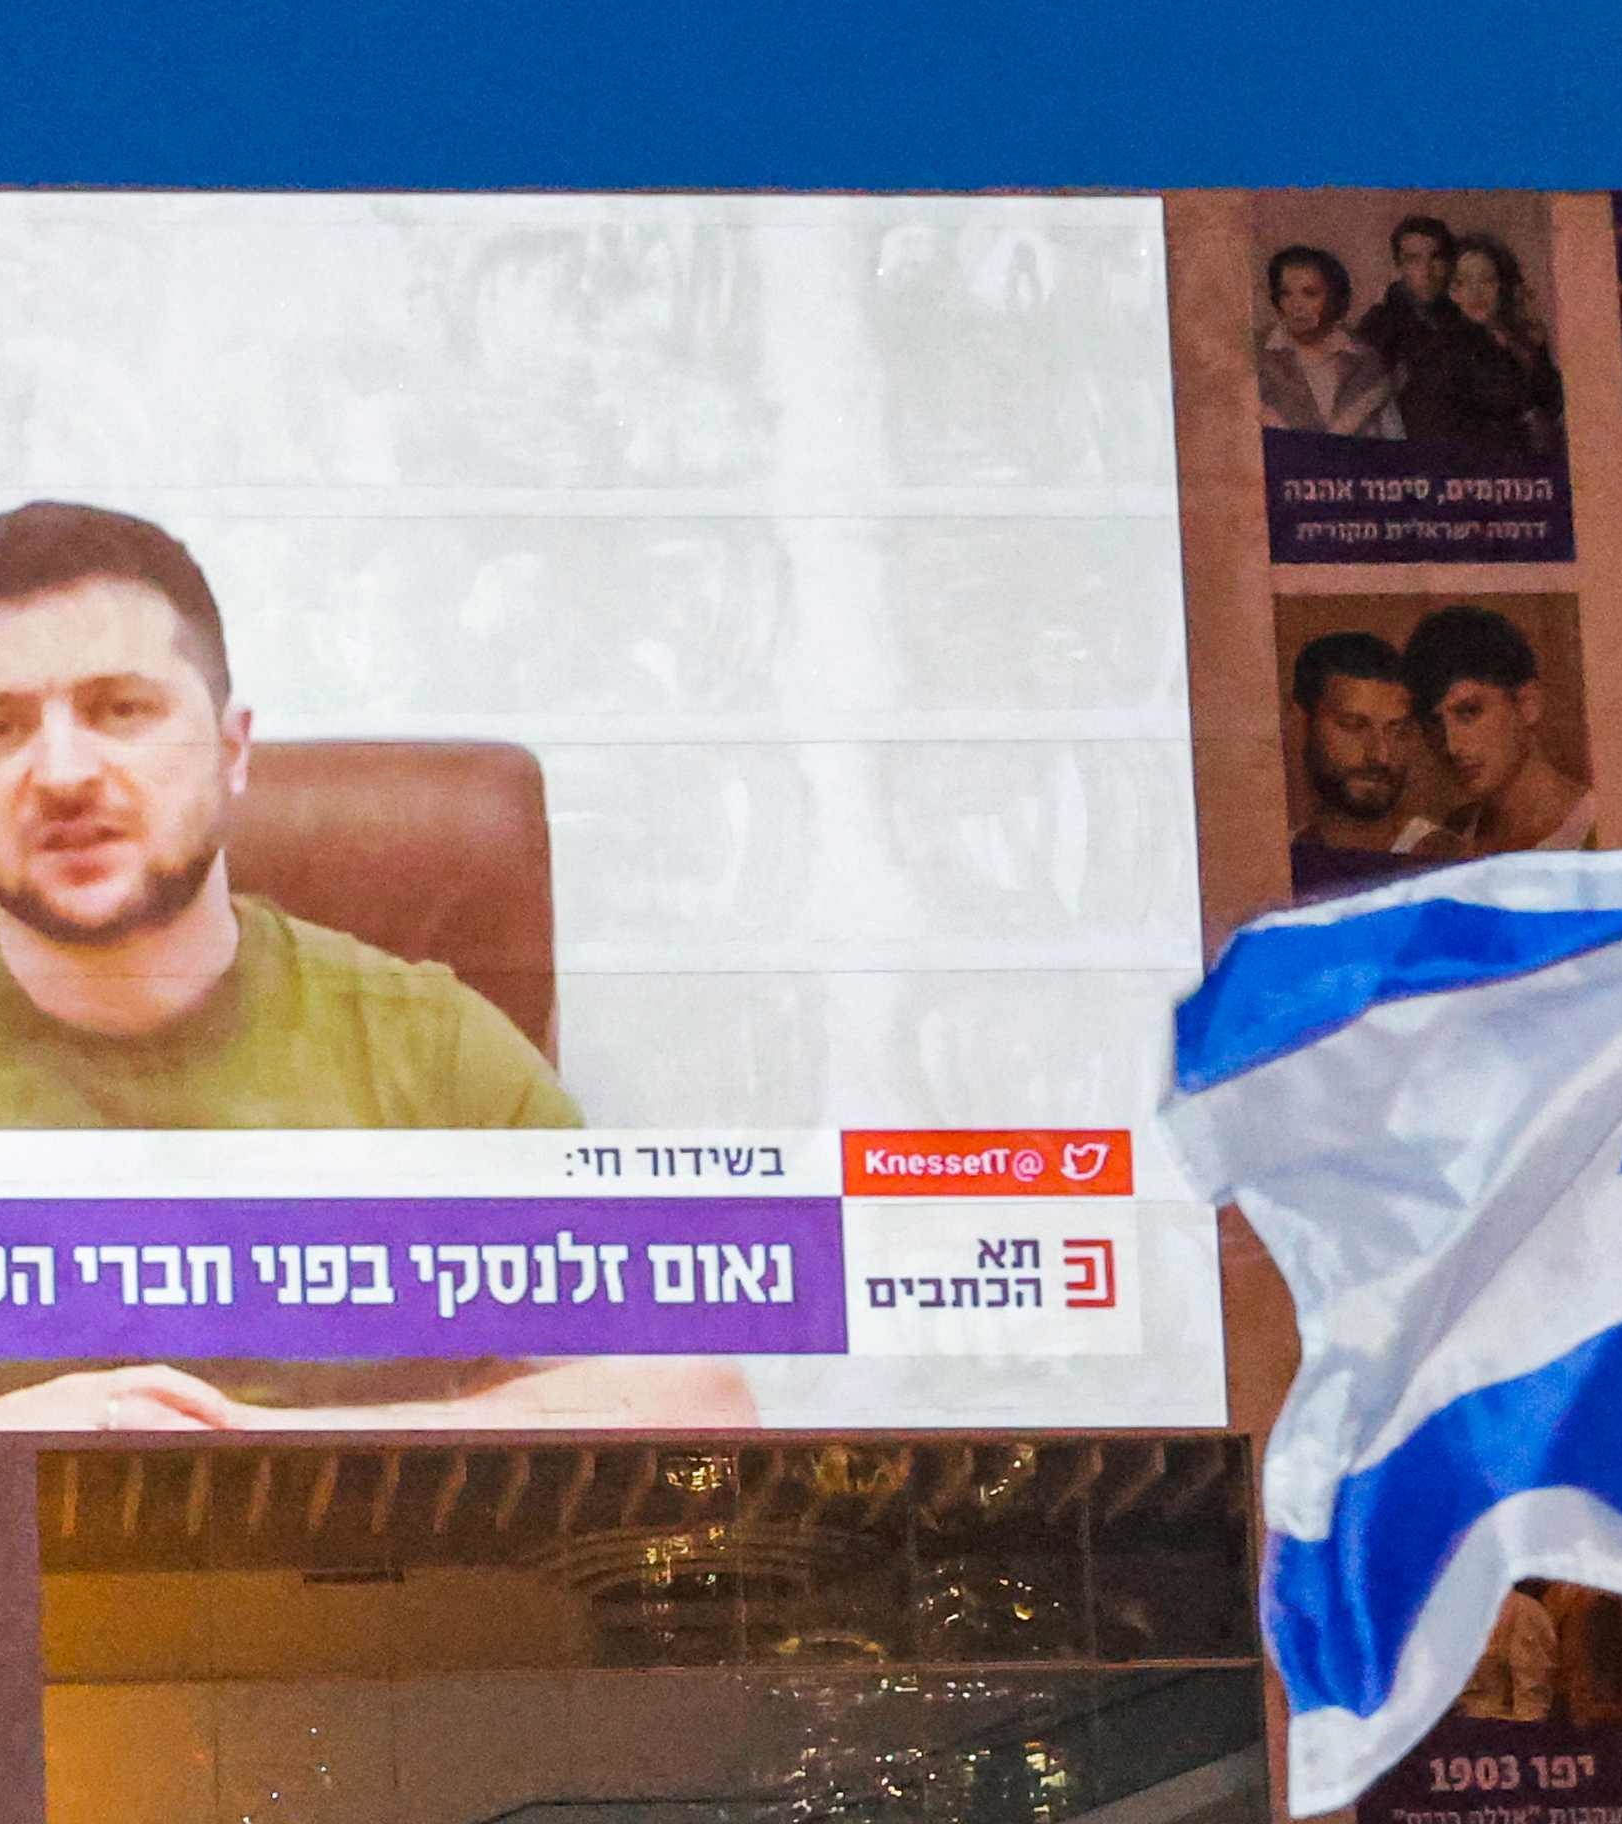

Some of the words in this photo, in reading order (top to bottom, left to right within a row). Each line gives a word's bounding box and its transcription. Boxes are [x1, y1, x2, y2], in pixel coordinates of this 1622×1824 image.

[1283, 478, 1354, 502] אהבה
[1360, 478, 1430, 501] סיפור
[565, 1146, 623, 1177] חי:
[635, 1146, 785, 1177] בשידור
[977, 1238, 1040, 1269] תא
[73, 1245, 233, 1305] חברי
[251, 1244, 395, 1305] בפני
[409, 1230, 629, 1319] זלנסקי
[646, 1243, 794, 1304] נאום
[865, 1277, 1043, 1308] הכתבים
[1429, 1754, 1521, 1792] 1903
[1529, 1754, 1596, 1790] יפו
